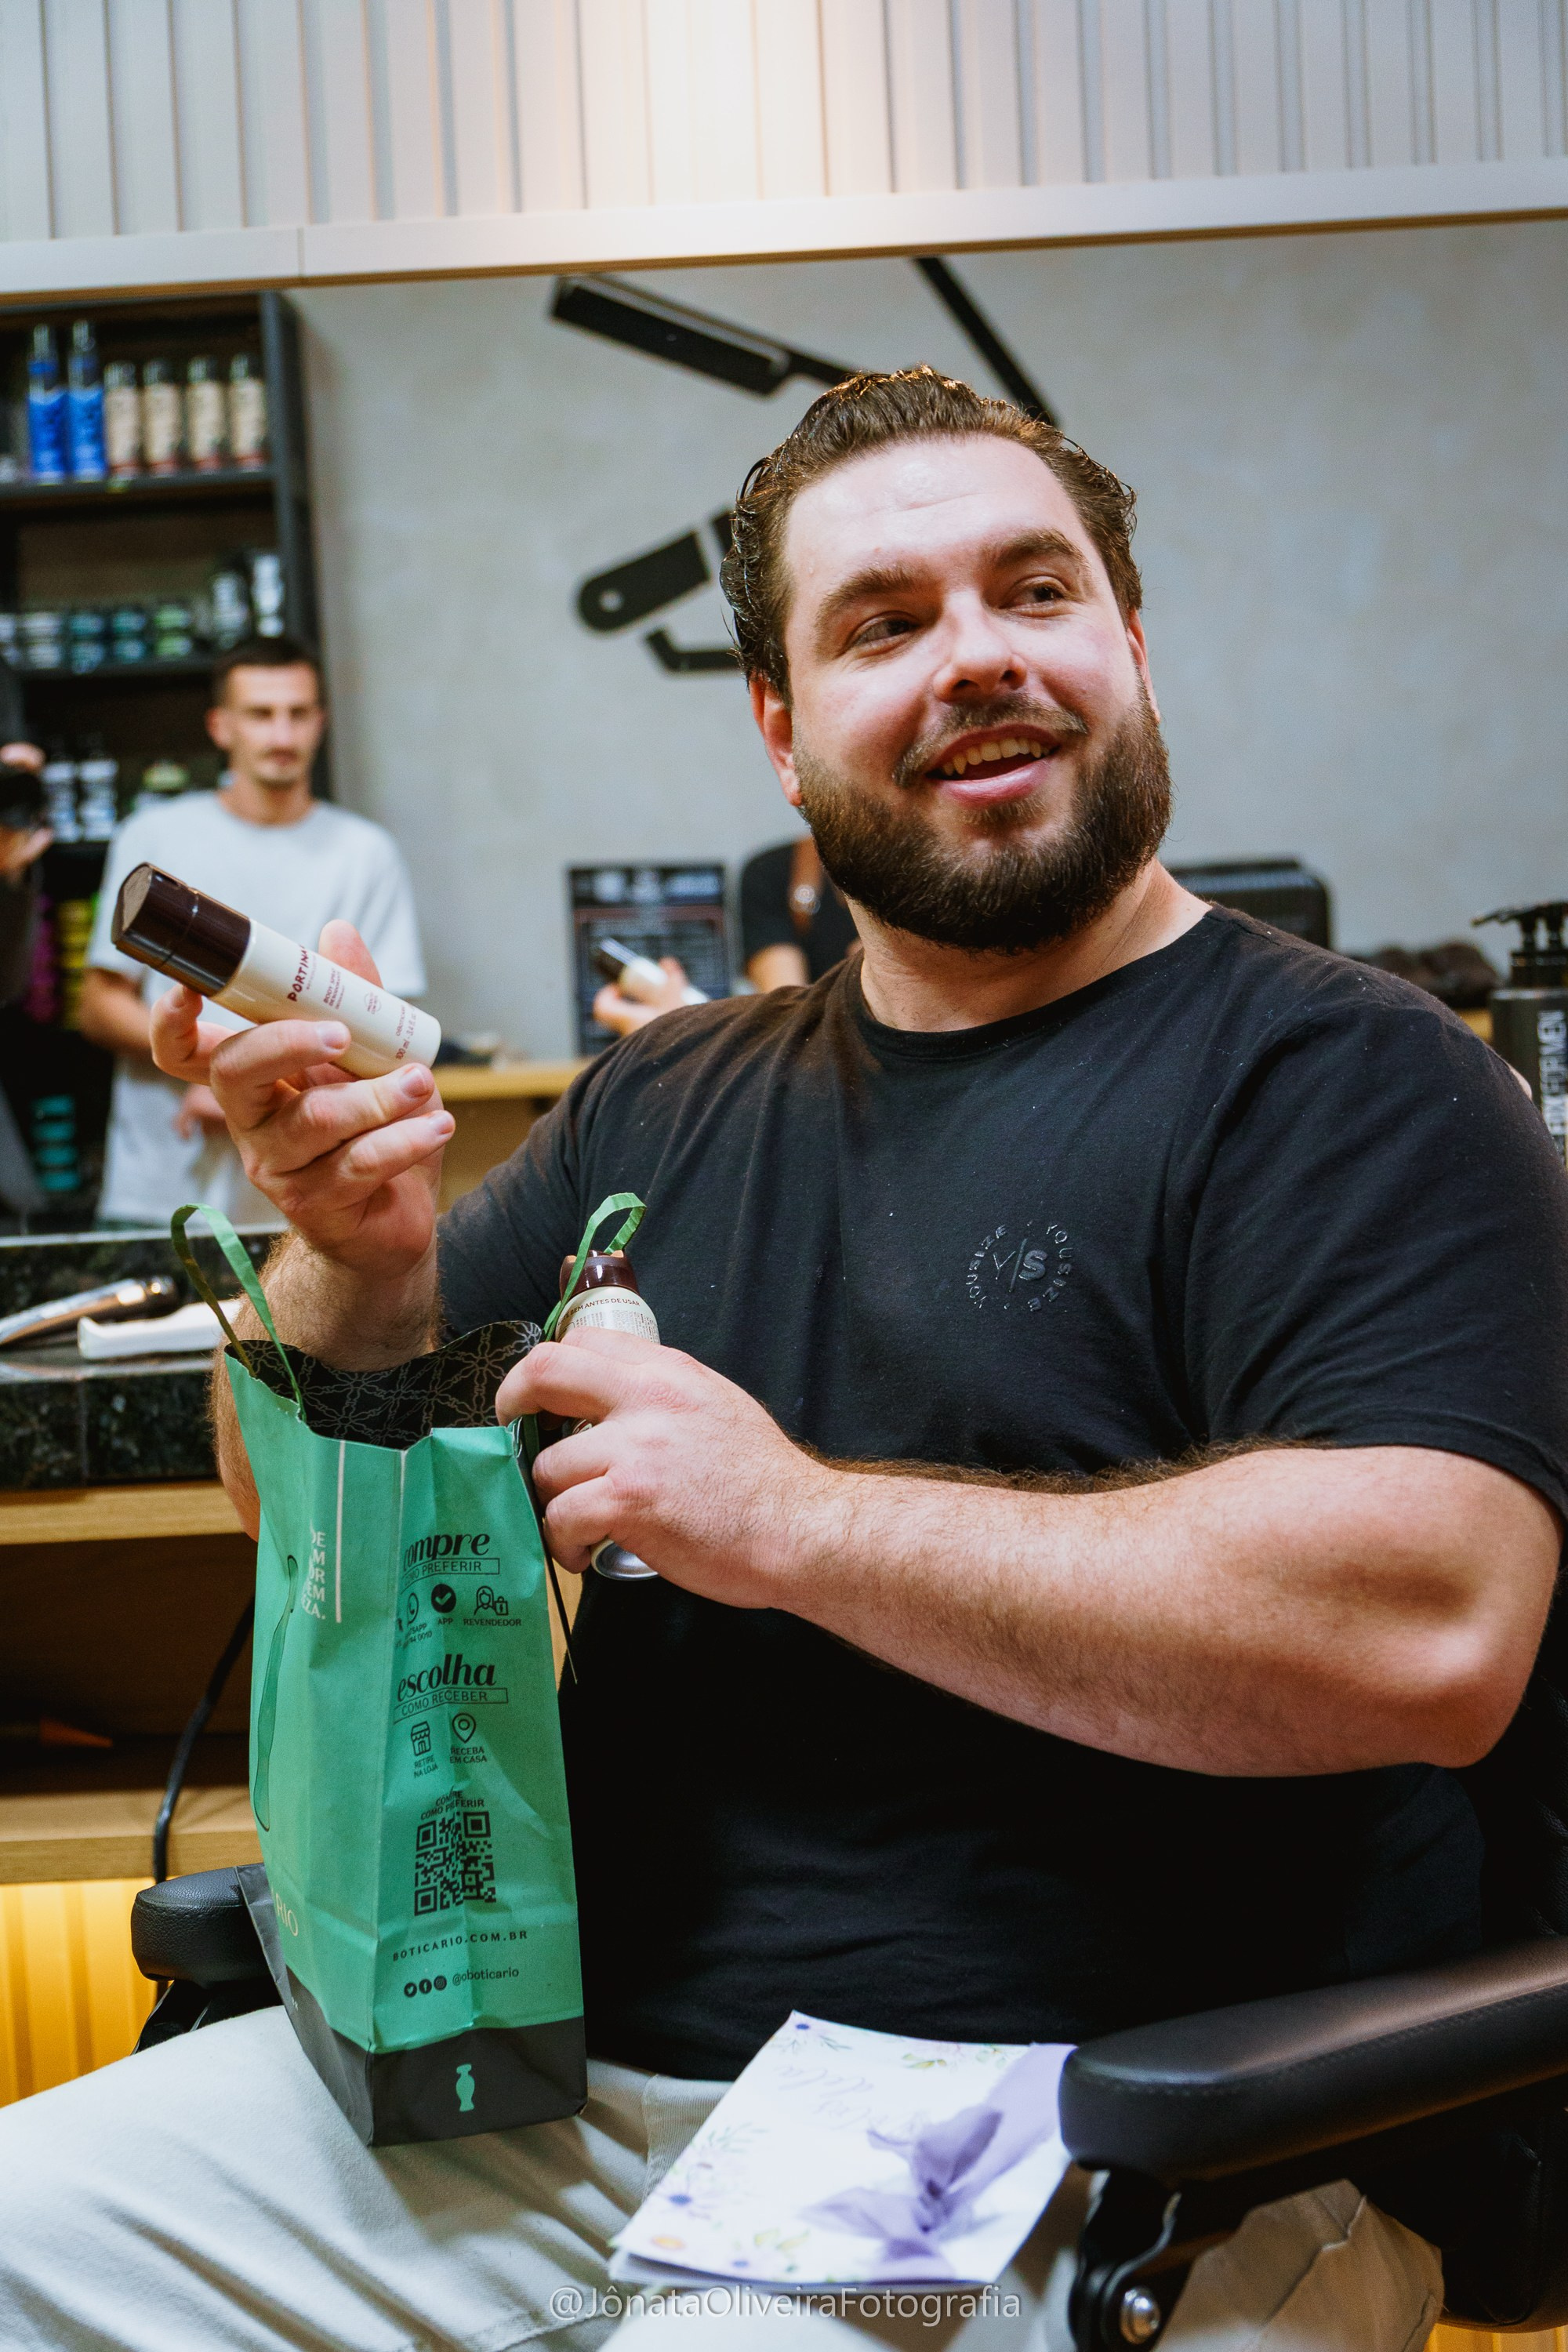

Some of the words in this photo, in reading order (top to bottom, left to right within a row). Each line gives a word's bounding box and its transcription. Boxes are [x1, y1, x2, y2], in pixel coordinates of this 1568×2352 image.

[571, 1305, 583, 1315] BEM
[585, 1298, 609, 1309] ANTES
[422, 1560, 481, 1576] PREFERIR
[463, 1618, 521, 1627] REVENDEDOR
[397, 1653, 496, 1702] escolha
[401, 1699, 429, 1716] COMO
[432, 1690, 488, 1705] RECEBER
[451, 1746, 485, 1755] RECEBA
[463, 1755, 487, 1763] CASA
[413, 1769, 424, 1778] NA
[424, 1764, 438, 1775] LOJA
[421, 1806, 443, 1820] COMO
[393, 1930, 528, 1962] BOTICARIO.COM.BR
[452, 1967, 519, 1986] @oboticario
